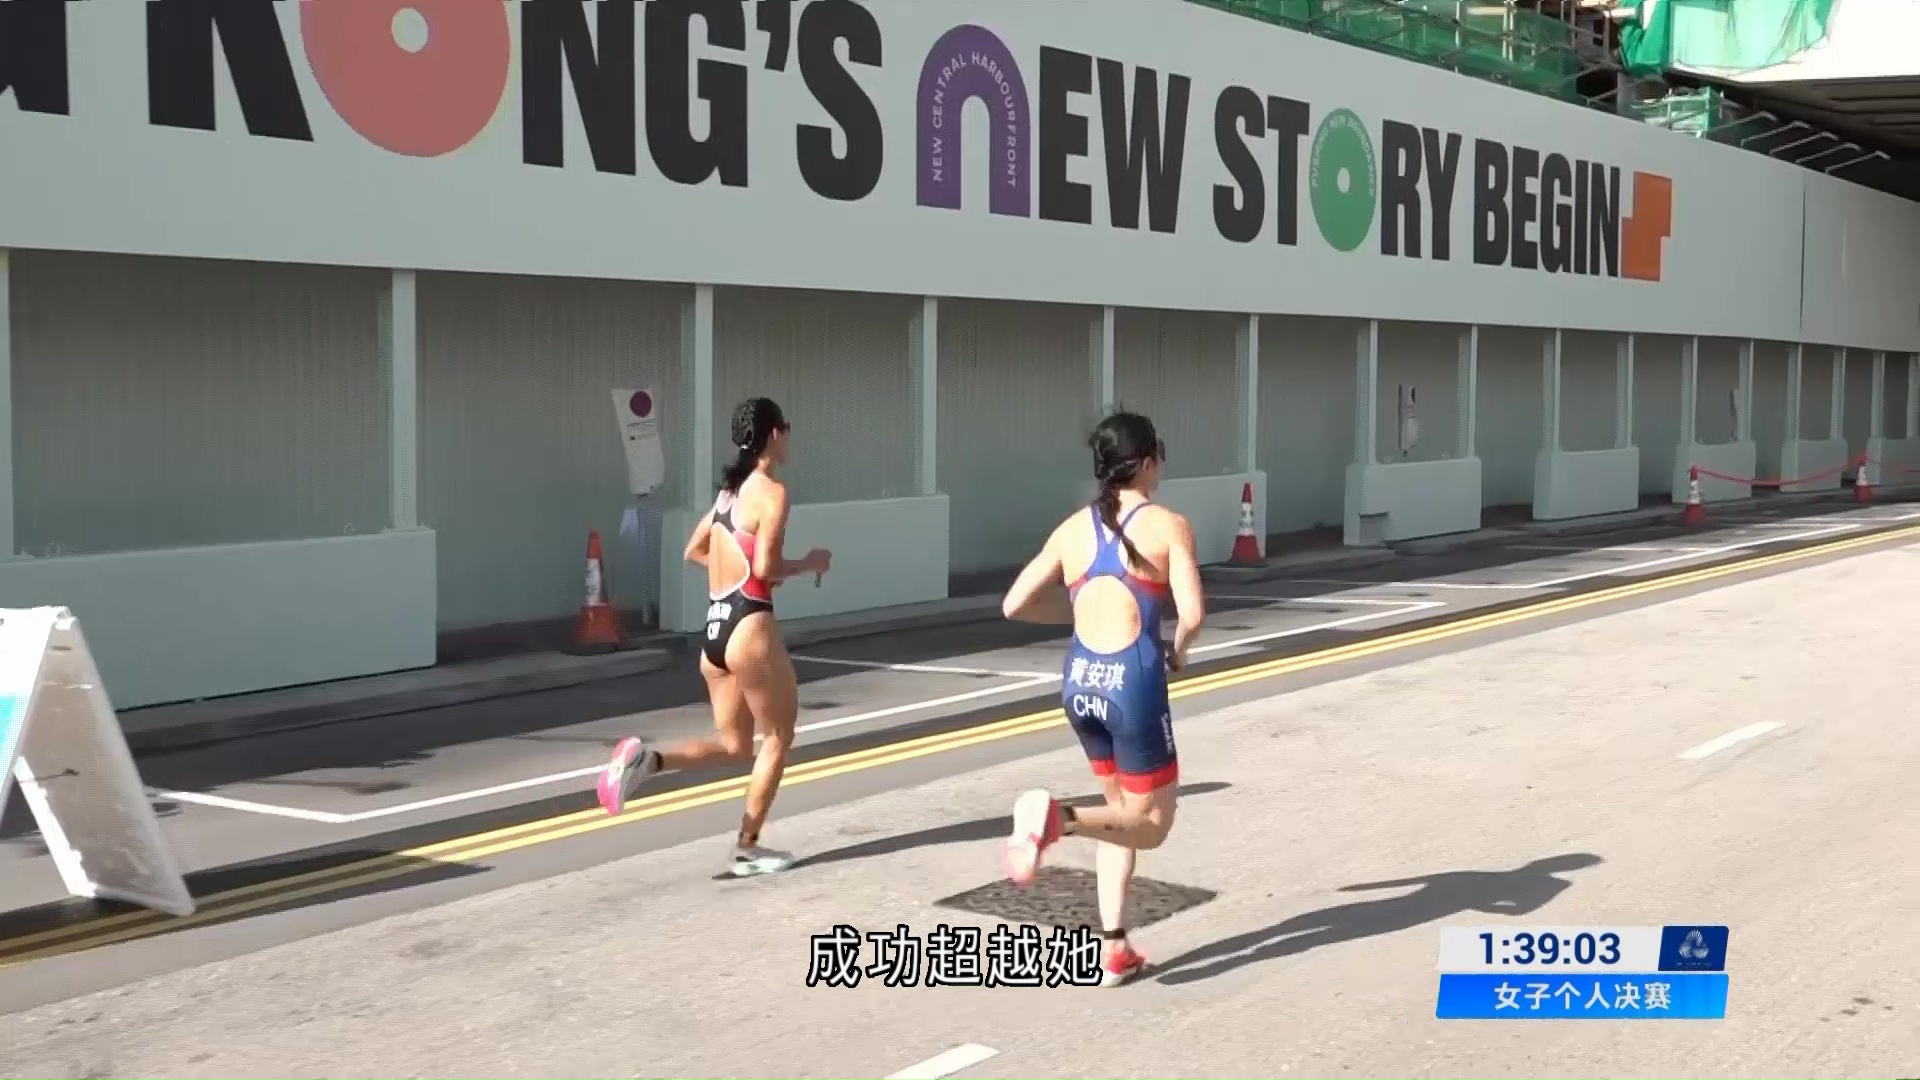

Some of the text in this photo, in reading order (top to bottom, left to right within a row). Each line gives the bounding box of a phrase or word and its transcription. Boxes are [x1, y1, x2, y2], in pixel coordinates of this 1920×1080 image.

[932, 50, 1017, 188] NEW CENTRAL HARBOURFRONT
[1213, 85, 1462, 260] STORY
[1073, 694, 1108, 720] CHN
